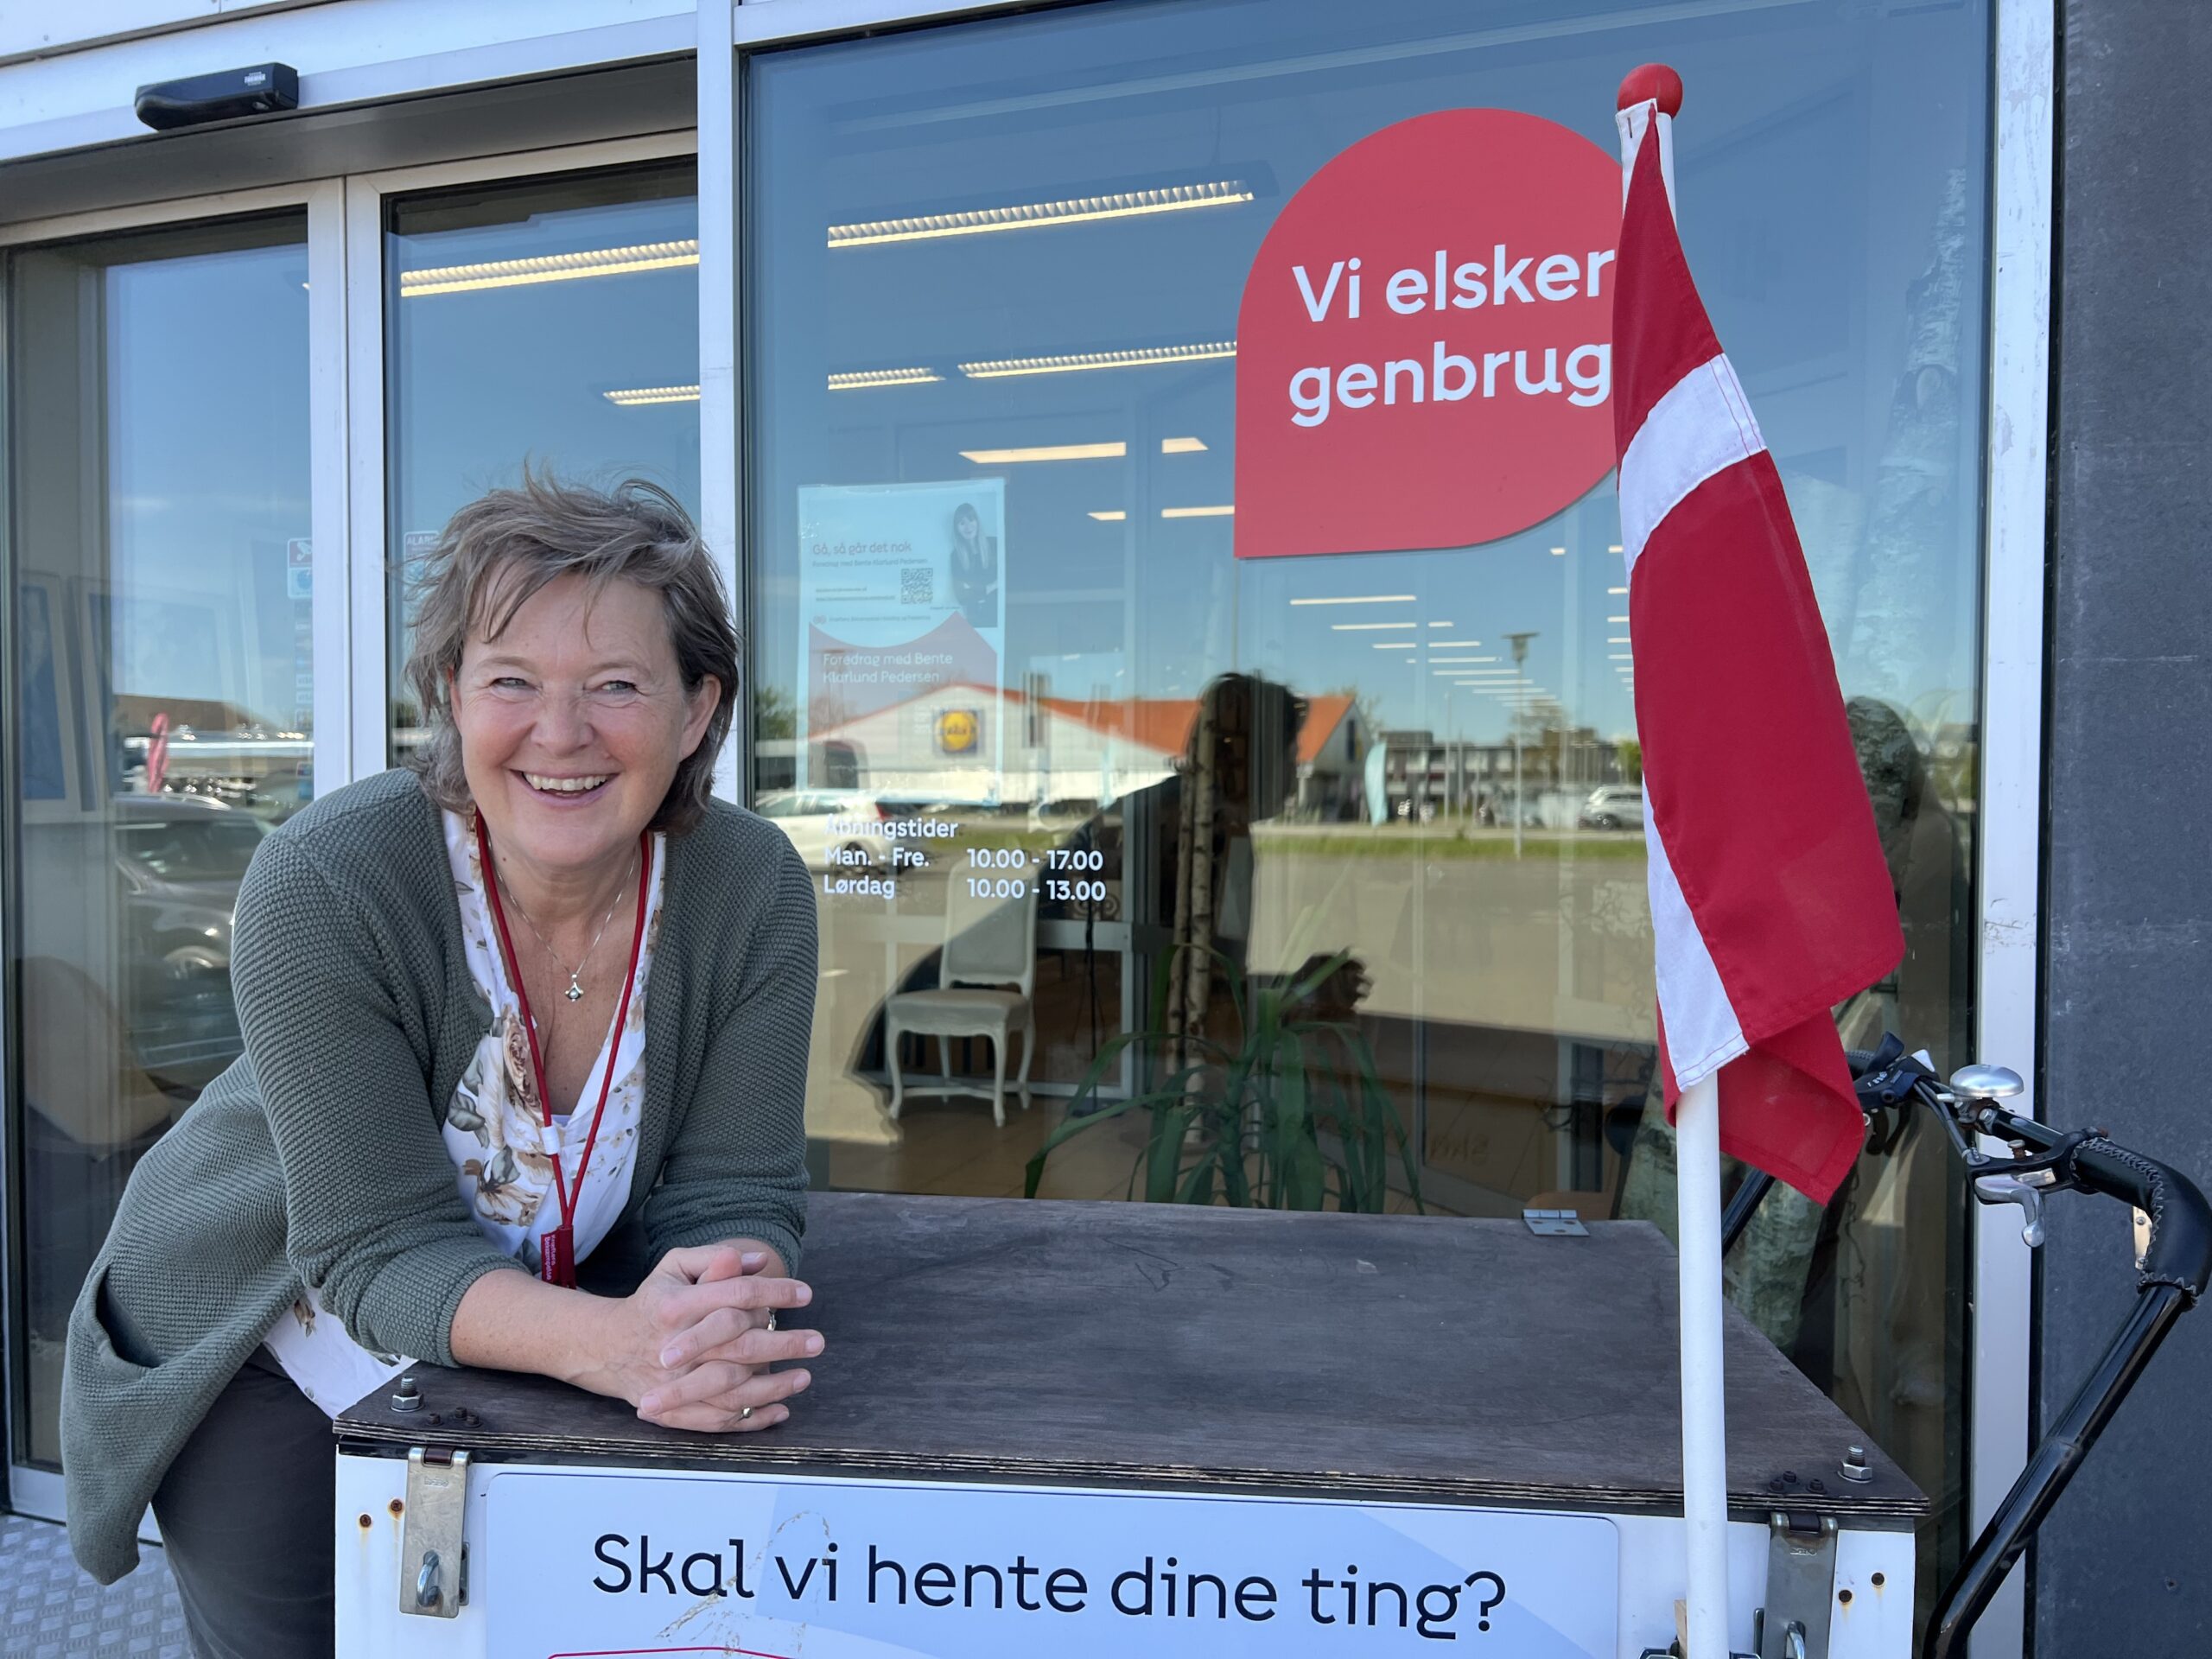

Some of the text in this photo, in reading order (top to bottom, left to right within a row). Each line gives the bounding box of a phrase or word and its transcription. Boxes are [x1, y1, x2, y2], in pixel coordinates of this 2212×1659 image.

[1292, 244, 1615, 322] Vi elsker
[1288, 340, 1611, 428] genbrug
[812, 541, 912, 556] Gå, så går det nok
[823, 652, 953, 667] Foredrag med Bente
[823, 671, 940, 683] Klarlund Pedersen
[823, 814, 958, 841] Åbningstider
[823, 847, 872, 866] Man.
[893, 848, 930, 867] Fre.
[967, 849, 1026, 869] 10.00
[1046, 849, 1104, 871] 17.00
[823, 874, 896, 899] Lørdag
[967, 878, 1026, 899] 10.00
[1046, 879, 1107, 901] 13.00
[592, 1533, 1506, 1640] Skal vi hente dine ting?
